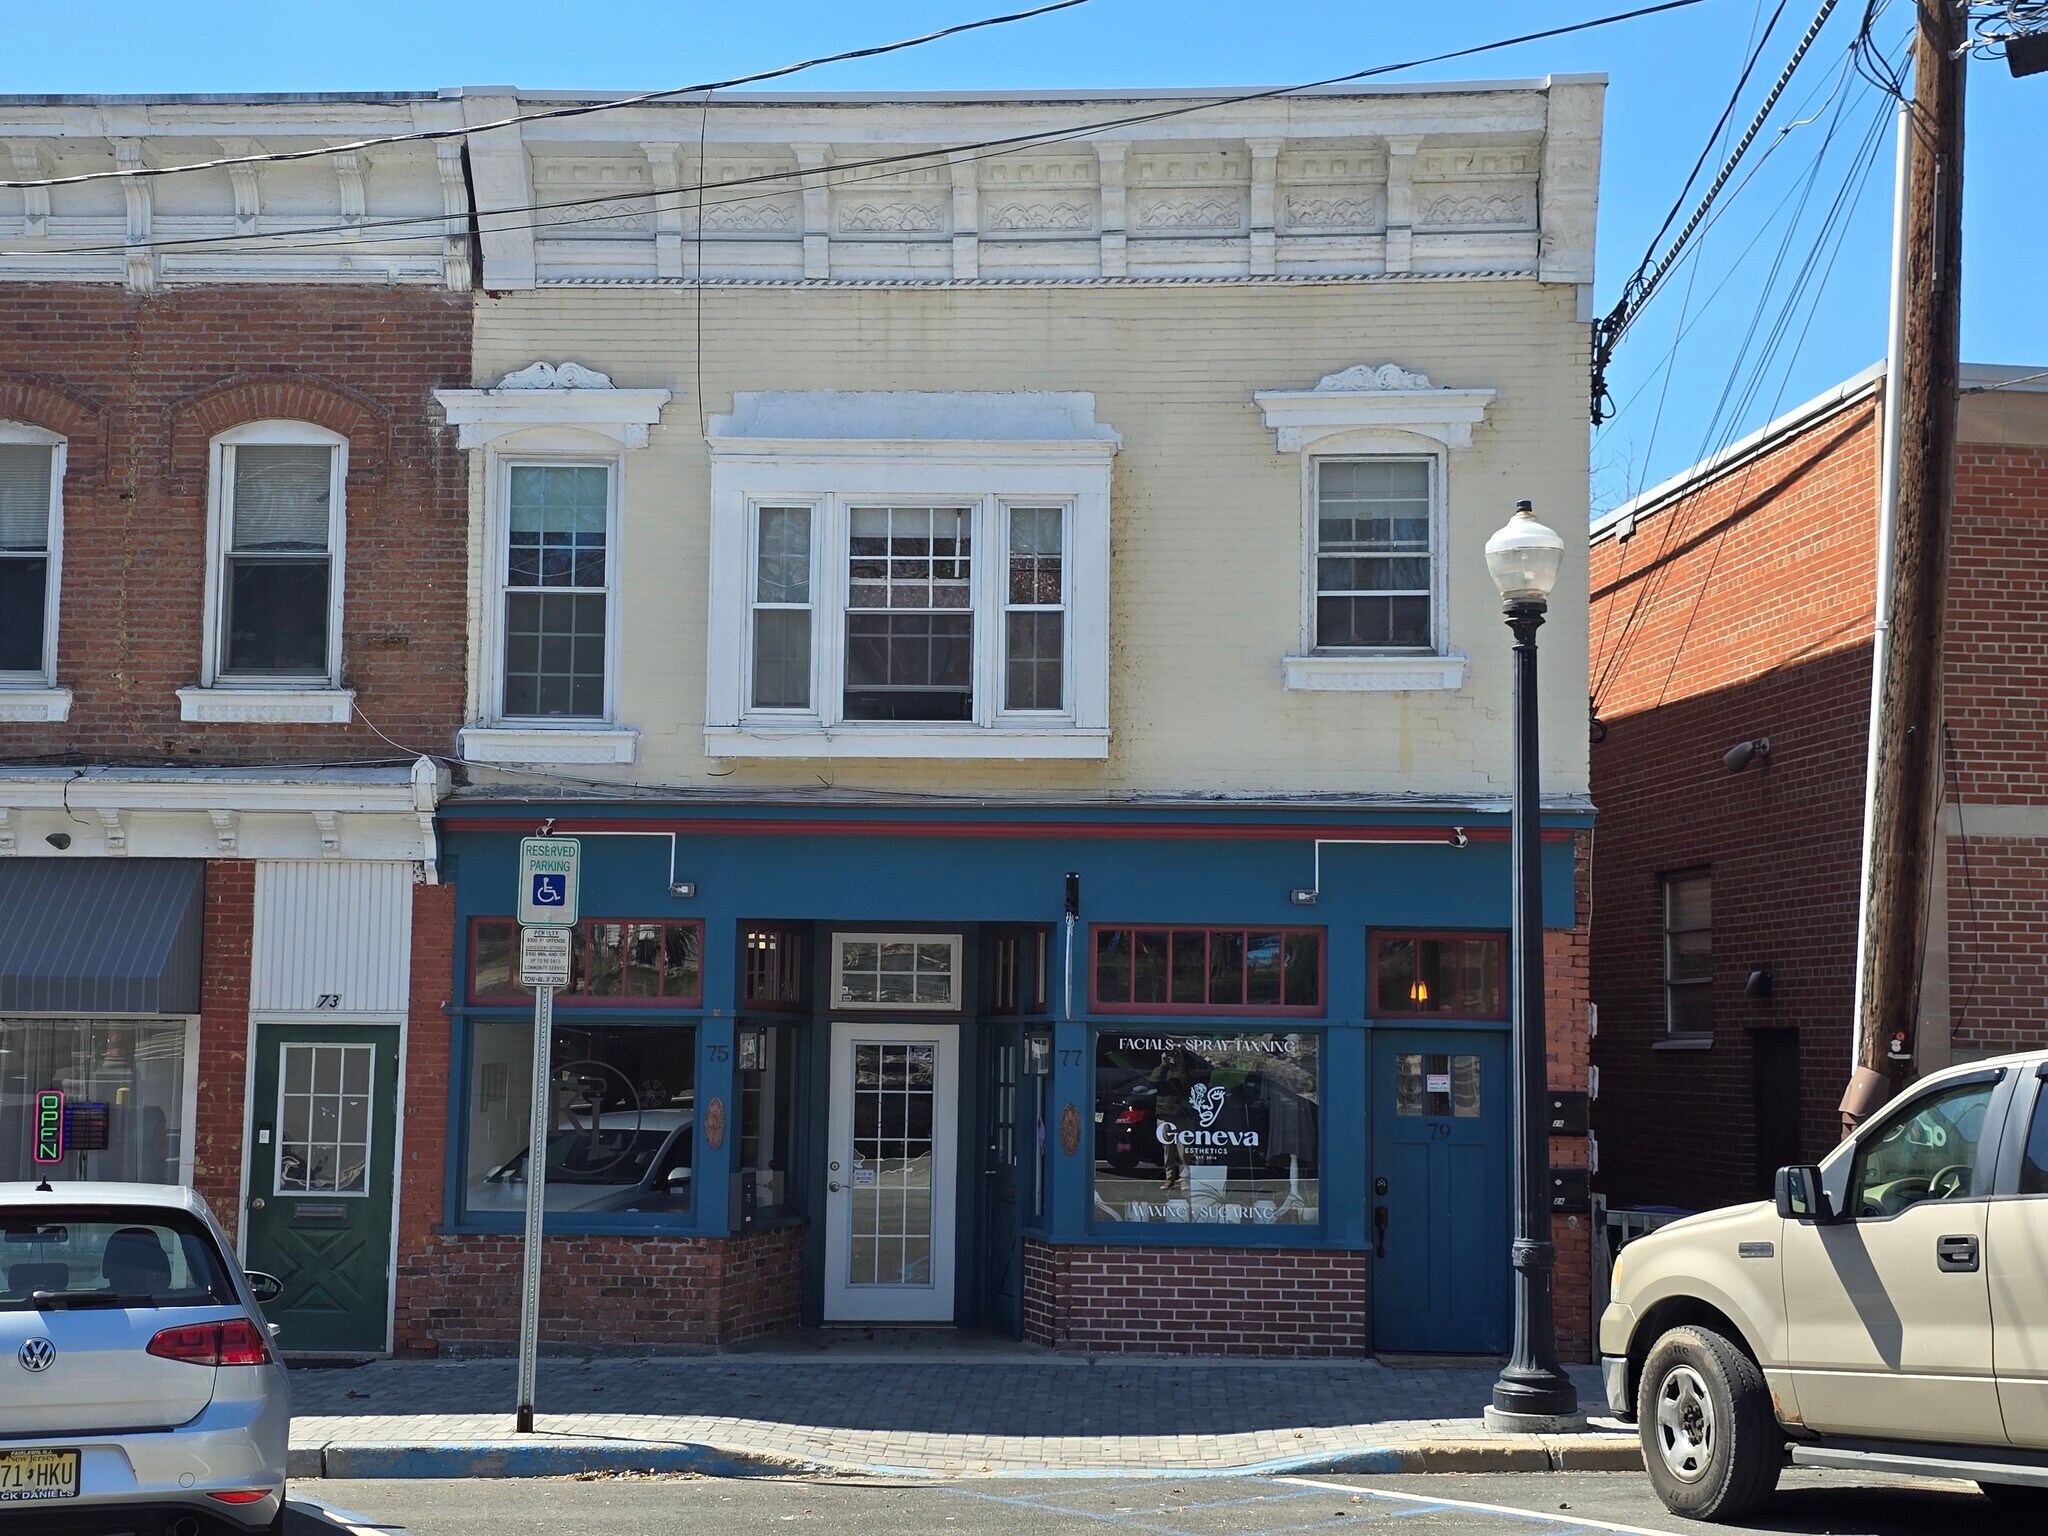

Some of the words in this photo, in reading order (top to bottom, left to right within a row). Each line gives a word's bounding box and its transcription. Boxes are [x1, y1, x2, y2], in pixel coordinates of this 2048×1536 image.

[526, 845, 576, 858] RESERVED
[530, 860, 571, 872] PARKING
[316, 994, 341, 1009] 73
[1119, 1037, 1174, 1051] FACIALS
[1184, 1039, 1229, 1052] SPRAY
[1235, 1040, 1296, 1053] TANNING
[706, 1044, 729, 1062] 75
[1058, 1048, 1082, 1066] 77
[39, 1095, 58, 1159] OPEN
[1155, 1121, 1259, 1147] Geneva
[1426, 1123, 1451, 1140] 79
[1184, 1147, 1228, 1155] ESTHETICS
[1131, 1205, 1187, 1218] WAXING
[1199, 1206, 1274, 1219] SUGARING
[7, 1454, 27, 1462] New
[28, 1454, 56, 1463] Jersey
[36, 1462, 73, 1486] HKU
[21, 1488, 75, 1499] DANIELS
